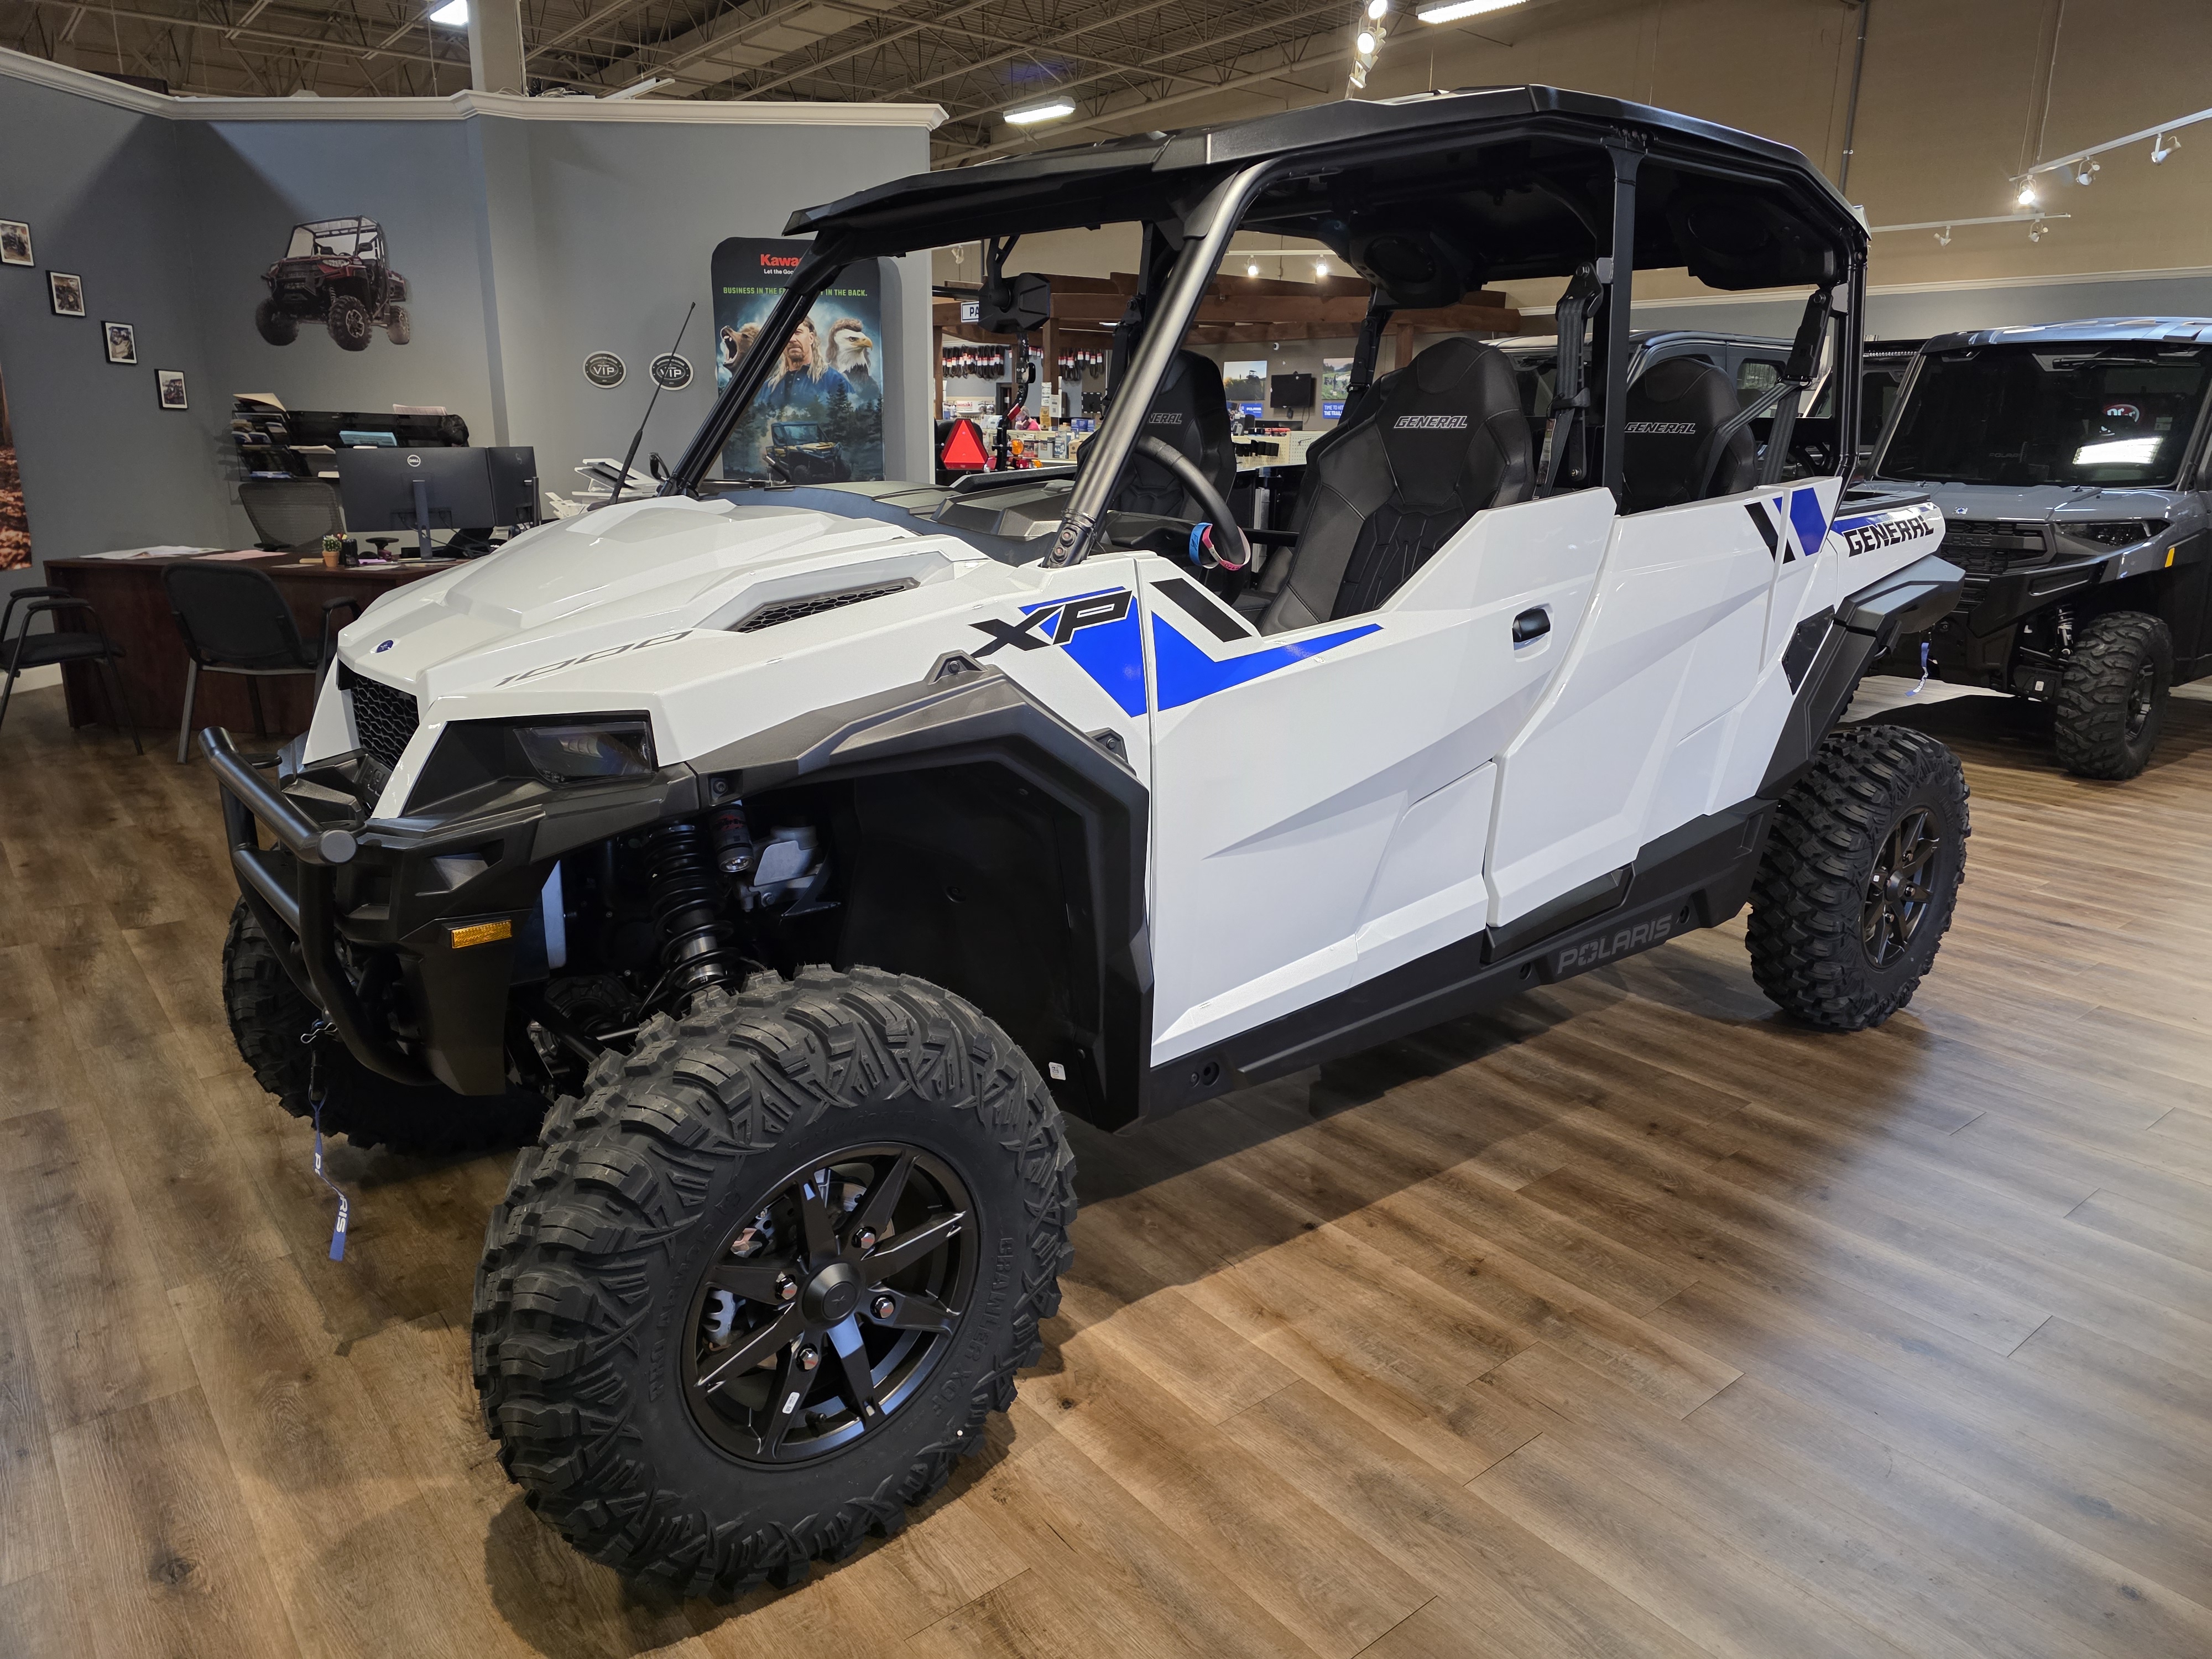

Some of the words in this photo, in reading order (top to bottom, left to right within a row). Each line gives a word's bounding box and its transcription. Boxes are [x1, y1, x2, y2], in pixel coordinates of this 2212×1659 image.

[760, 254, 802, 267] Kawa
[970, 306, 979, 317] PA
[593, 366, 614, 375] VIP
[1149, 413, 1182, 424] NERAL
[1394, 416, 1468, 429] GENERAL
[1624, 422, 1696, 434] GENERAL
[1843, 515, 1934, 557] GENERAL
[968, 590, 1133, 659] XP
[492, 630, 693, 688] 1000
[1557, 914, 1673, 975] POLARIS
[963, 1237, 1015, 1362] CRAWLER
